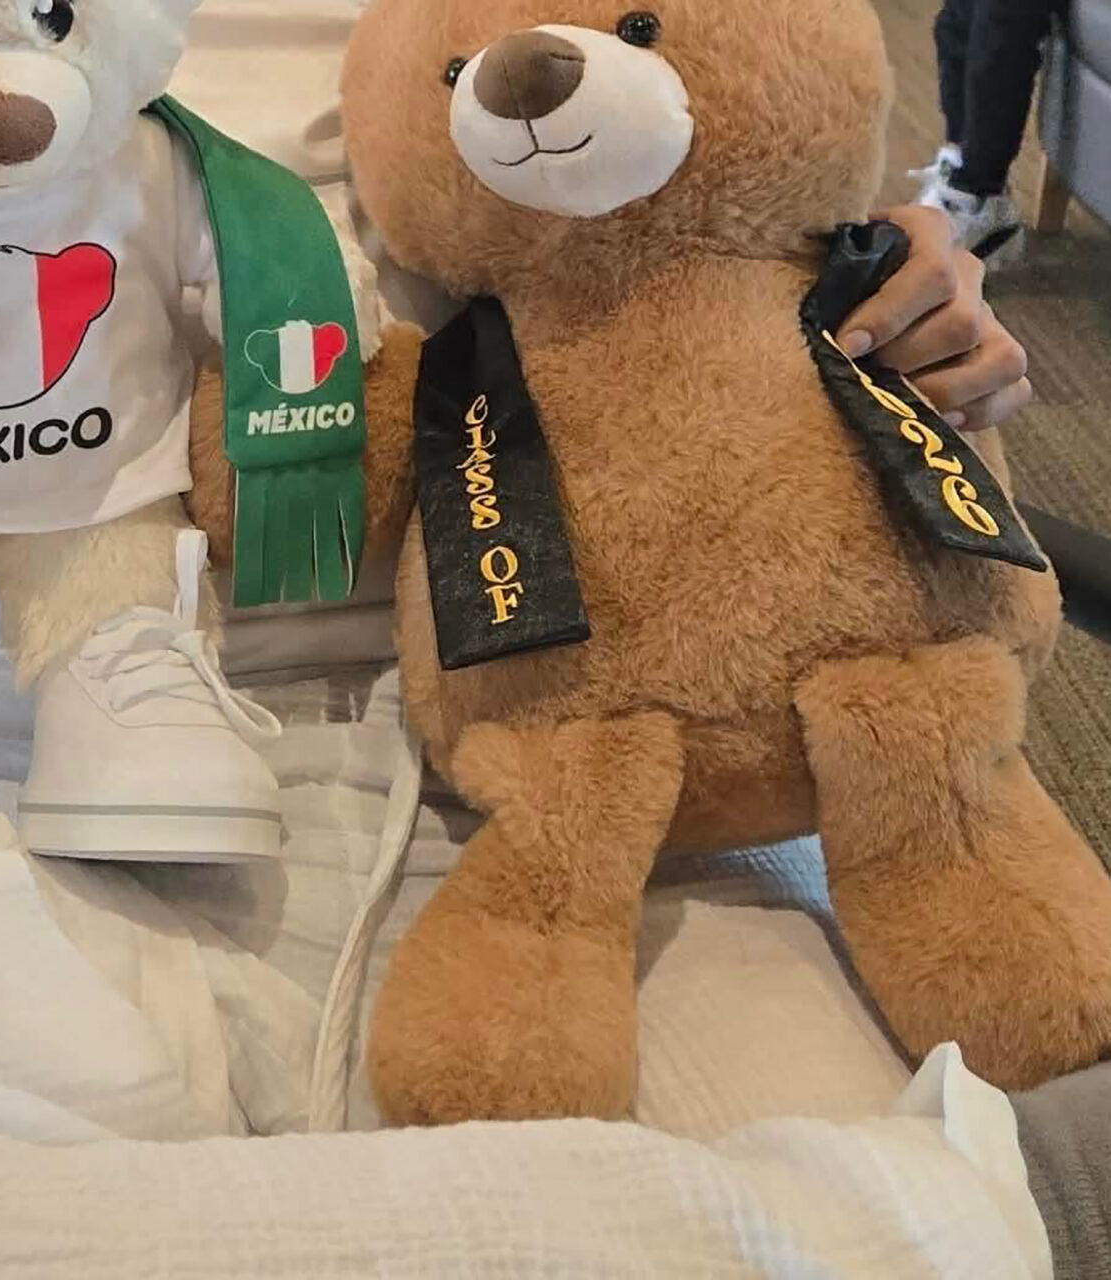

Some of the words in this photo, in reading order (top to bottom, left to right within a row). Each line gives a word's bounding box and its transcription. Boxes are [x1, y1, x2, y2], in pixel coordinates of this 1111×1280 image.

[247, 402, 356, 436] MÉXICO
[456, 394, 502, 530] CLASS
[479, 545, 524, 625] OF
[821, 329, 1001, 538] 026
